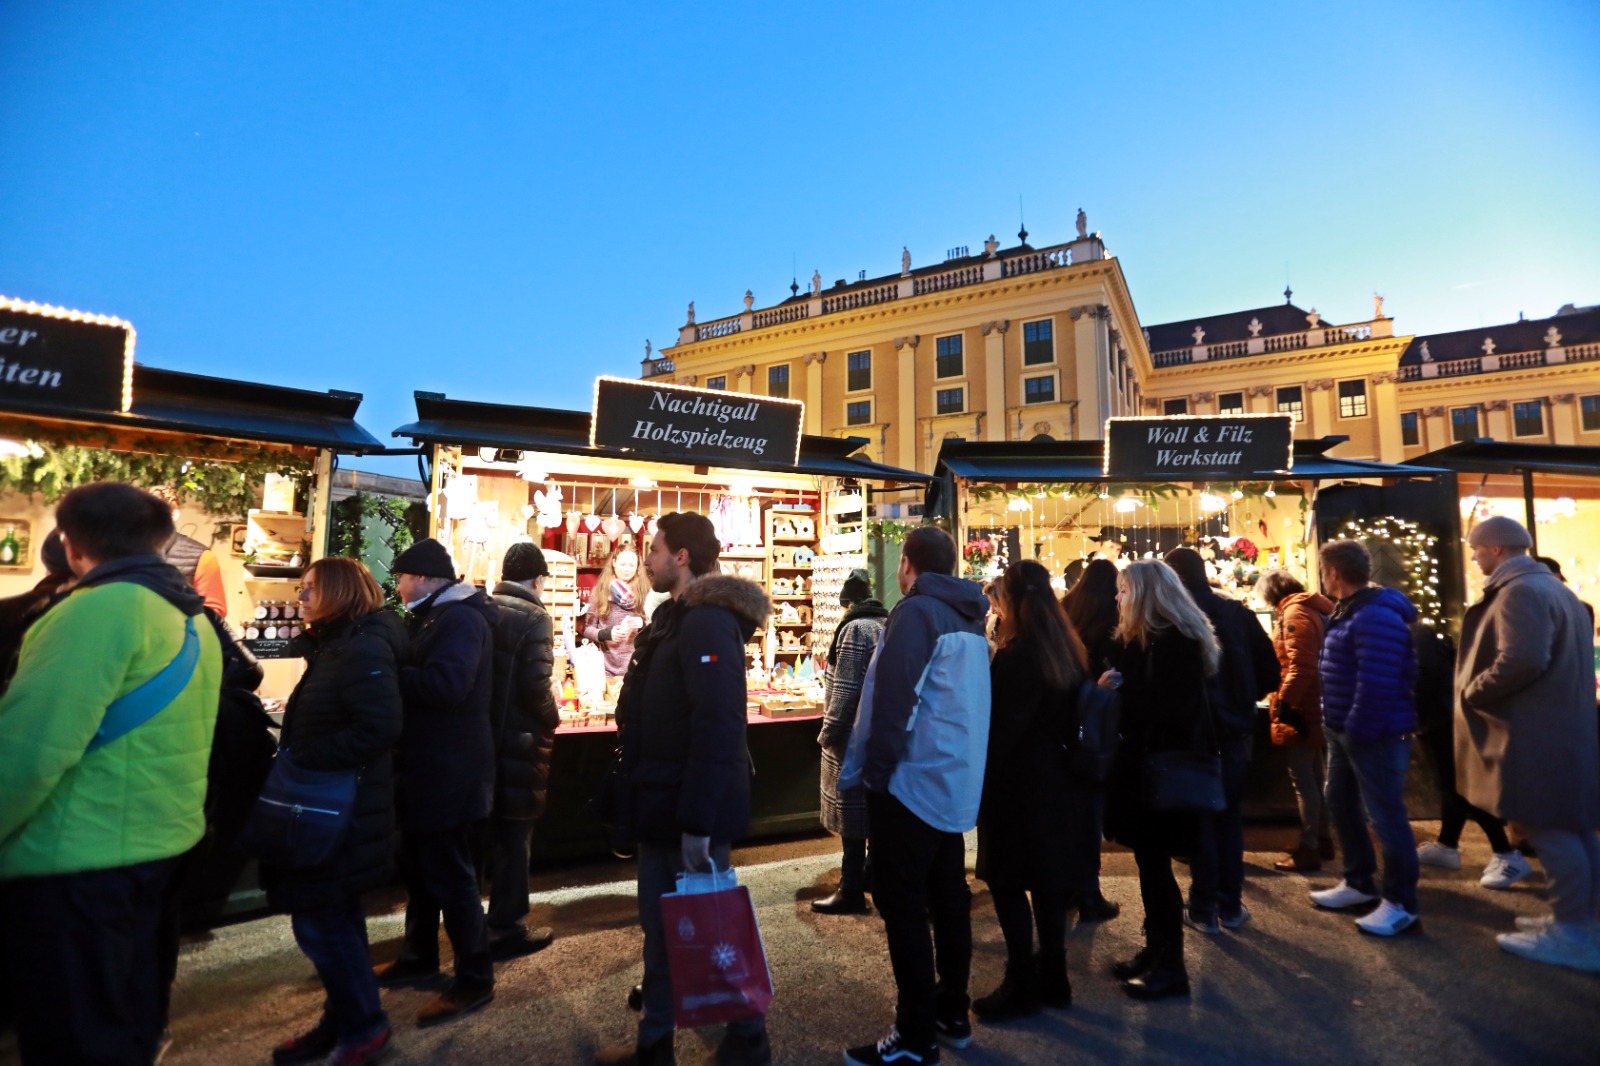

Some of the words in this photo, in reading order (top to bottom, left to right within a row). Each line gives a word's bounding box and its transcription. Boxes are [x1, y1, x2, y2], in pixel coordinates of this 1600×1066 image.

[648, 390, 760, 424] Nachtigall
[631, 420, 768, 455] Holzspielzeug
[1147, 426, 1189, 444] Woll
[1193, 426, 1210, 443] &
[1216, 425, 1253, 444] Filz
[1156, 449, 1242, 466] Werkstatt
